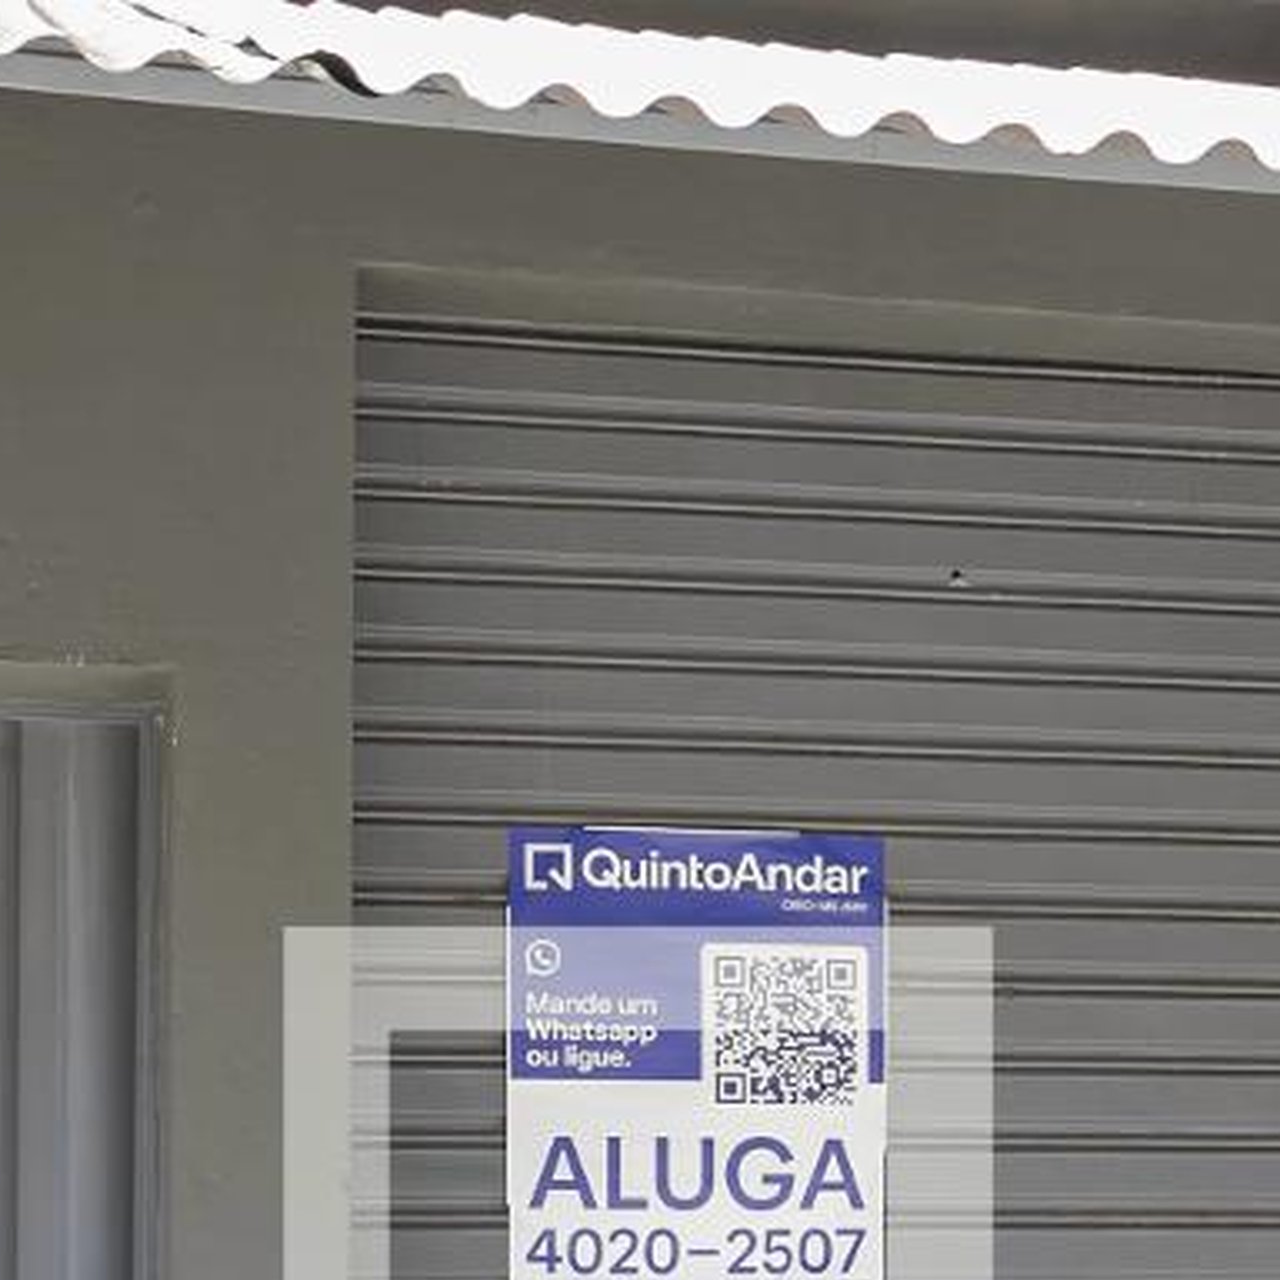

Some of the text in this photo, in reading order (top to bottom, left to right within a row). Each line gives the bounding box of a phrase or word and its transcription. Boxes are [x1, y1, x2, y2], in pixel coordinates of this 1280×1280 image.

[582, 847, 869, 894] QuintoAndar
[525, 1017, 658, 1046] Whatsapp
[525, 1043, 631, 1073] ou ligue.
[528, 1136, 866, 1212] ALUGA
[526, 1228, 867, 1275] 4020-2507
